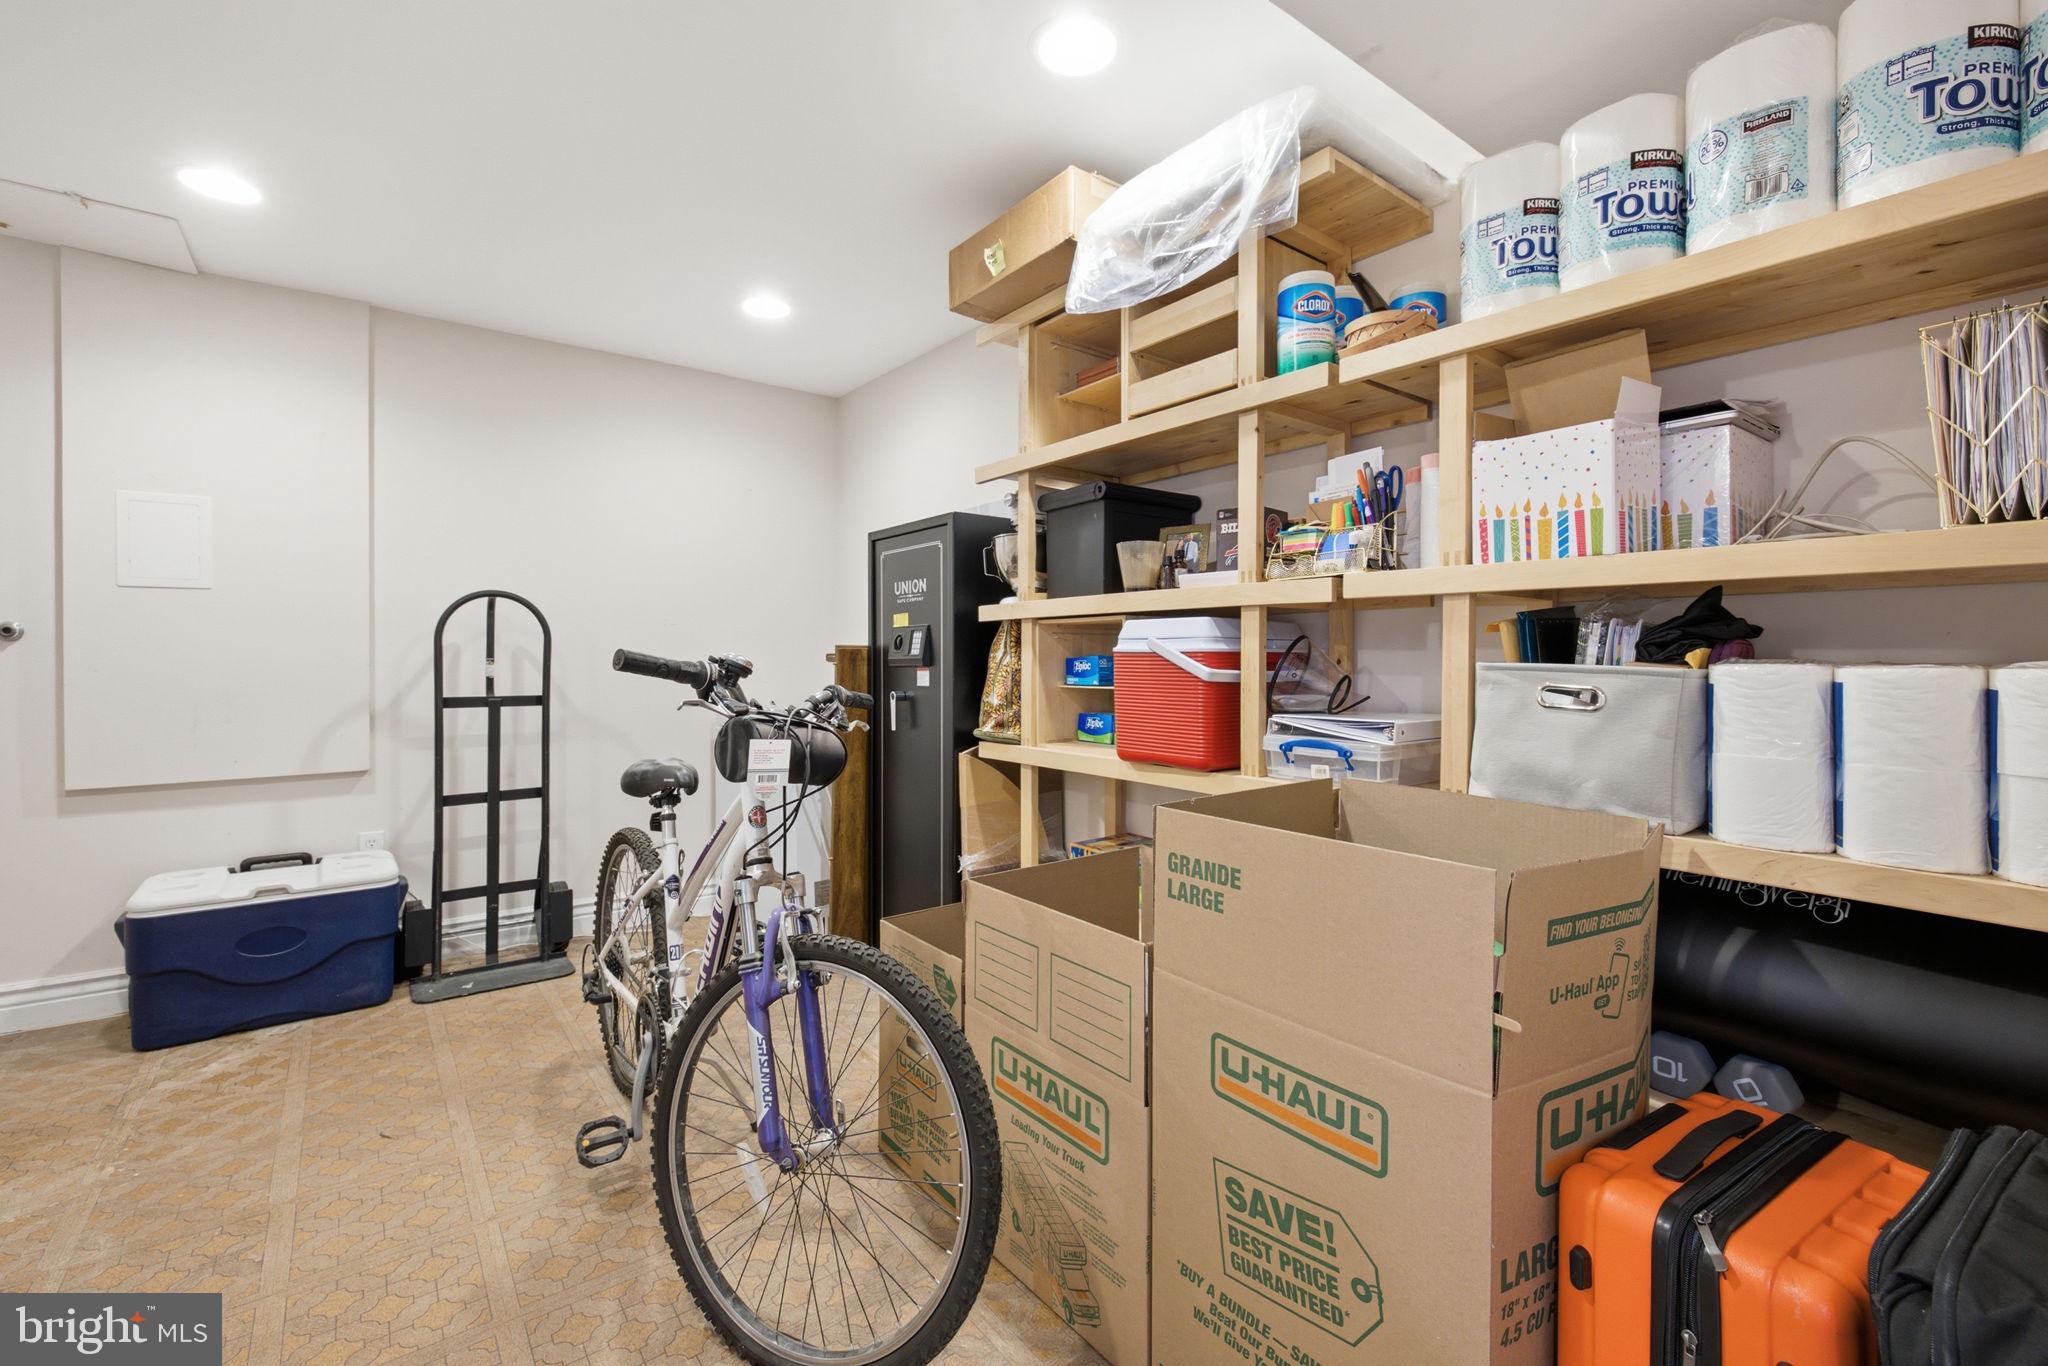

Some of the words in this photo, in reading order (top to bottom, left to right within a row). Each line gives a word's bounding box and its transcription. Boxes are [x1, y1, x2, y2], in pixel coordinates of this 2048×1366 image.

[1297, 299, 1330, 312] CLOROX
[894, 578, 927, 595] UNION
[1167, 851, 1242, 891] GRANDE
[1167, 878, 1225, 915] LARGE
[1550, 921, 1573, 941] FIND
[1574, 916, 1599, 936] YOUR
[1550, 977, 1594, 1005] U-Haul
[1596, 974, 1620, 992] App
[998, 1047, 1101, 1136] U-HAUL
[1010, 1114, 1040, 1144] Loading
[1042, 1134, 1060, 1156] Your
[1062, 1148, 1086, 1174] Truck
[1225, 1176, 1337, 1258] SAVE!
[1228, 1224, 1273, 1264] BEST
[1278, 1249, 1340, 1300] PRICE
[1193, 1305, 1221, 1337] We'll
[1223, 1331, 1250, 1360] Give
[1206, 1284, 1215, 1299] A
[1219, 1291, 1272, 1340] BUNDLE
[1209, 1302, 1236, 1332] Beat
[1239, 1326, 1262, 1350] Our
[1500, 1320, 1523, 1348] 4.5
[1527, 1306, 1545, 1335] CU
